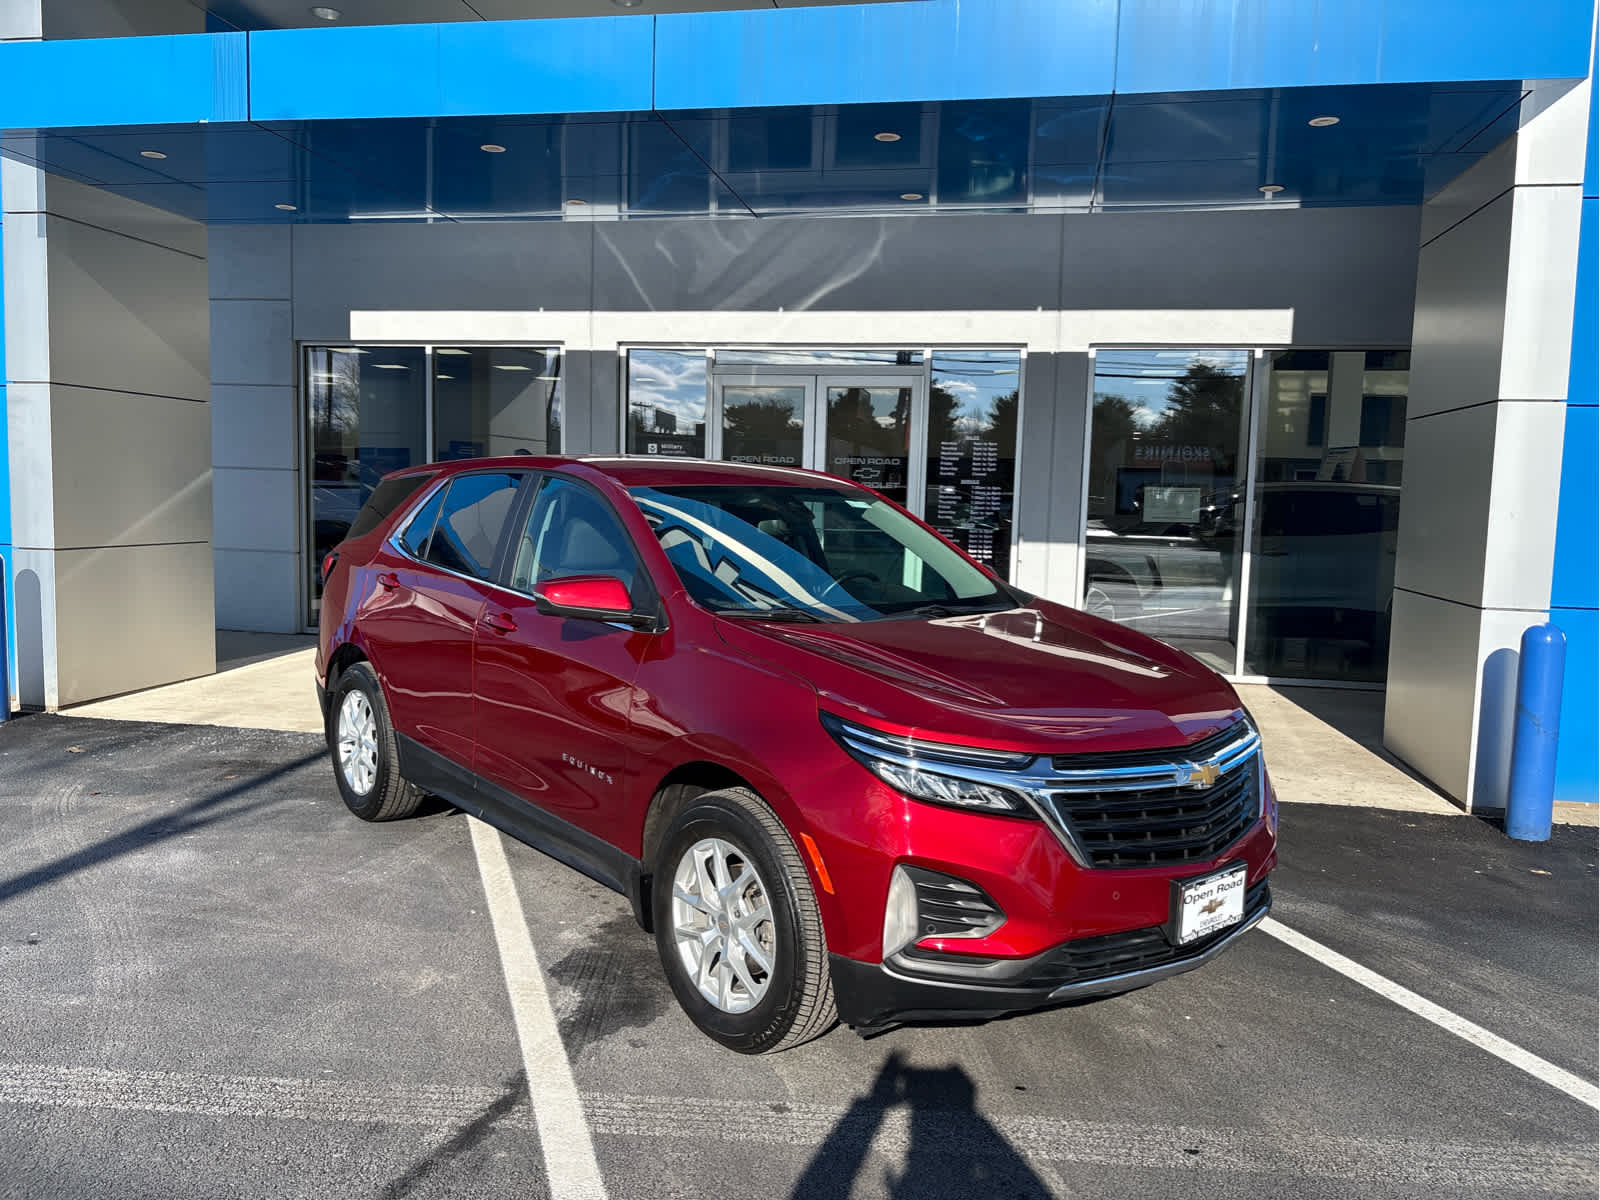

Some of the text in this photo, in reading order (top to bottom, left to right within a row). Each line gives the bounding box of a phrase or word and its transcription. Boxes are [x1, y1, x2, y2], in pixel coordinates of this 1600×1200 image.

[731, 455, 795, 464] OPEN ROAD
[834, 457, 868, 465] OPEN
[562, 752, 613, 785] EQUINOX
[1184, 875, 1243, 905] Open Road
